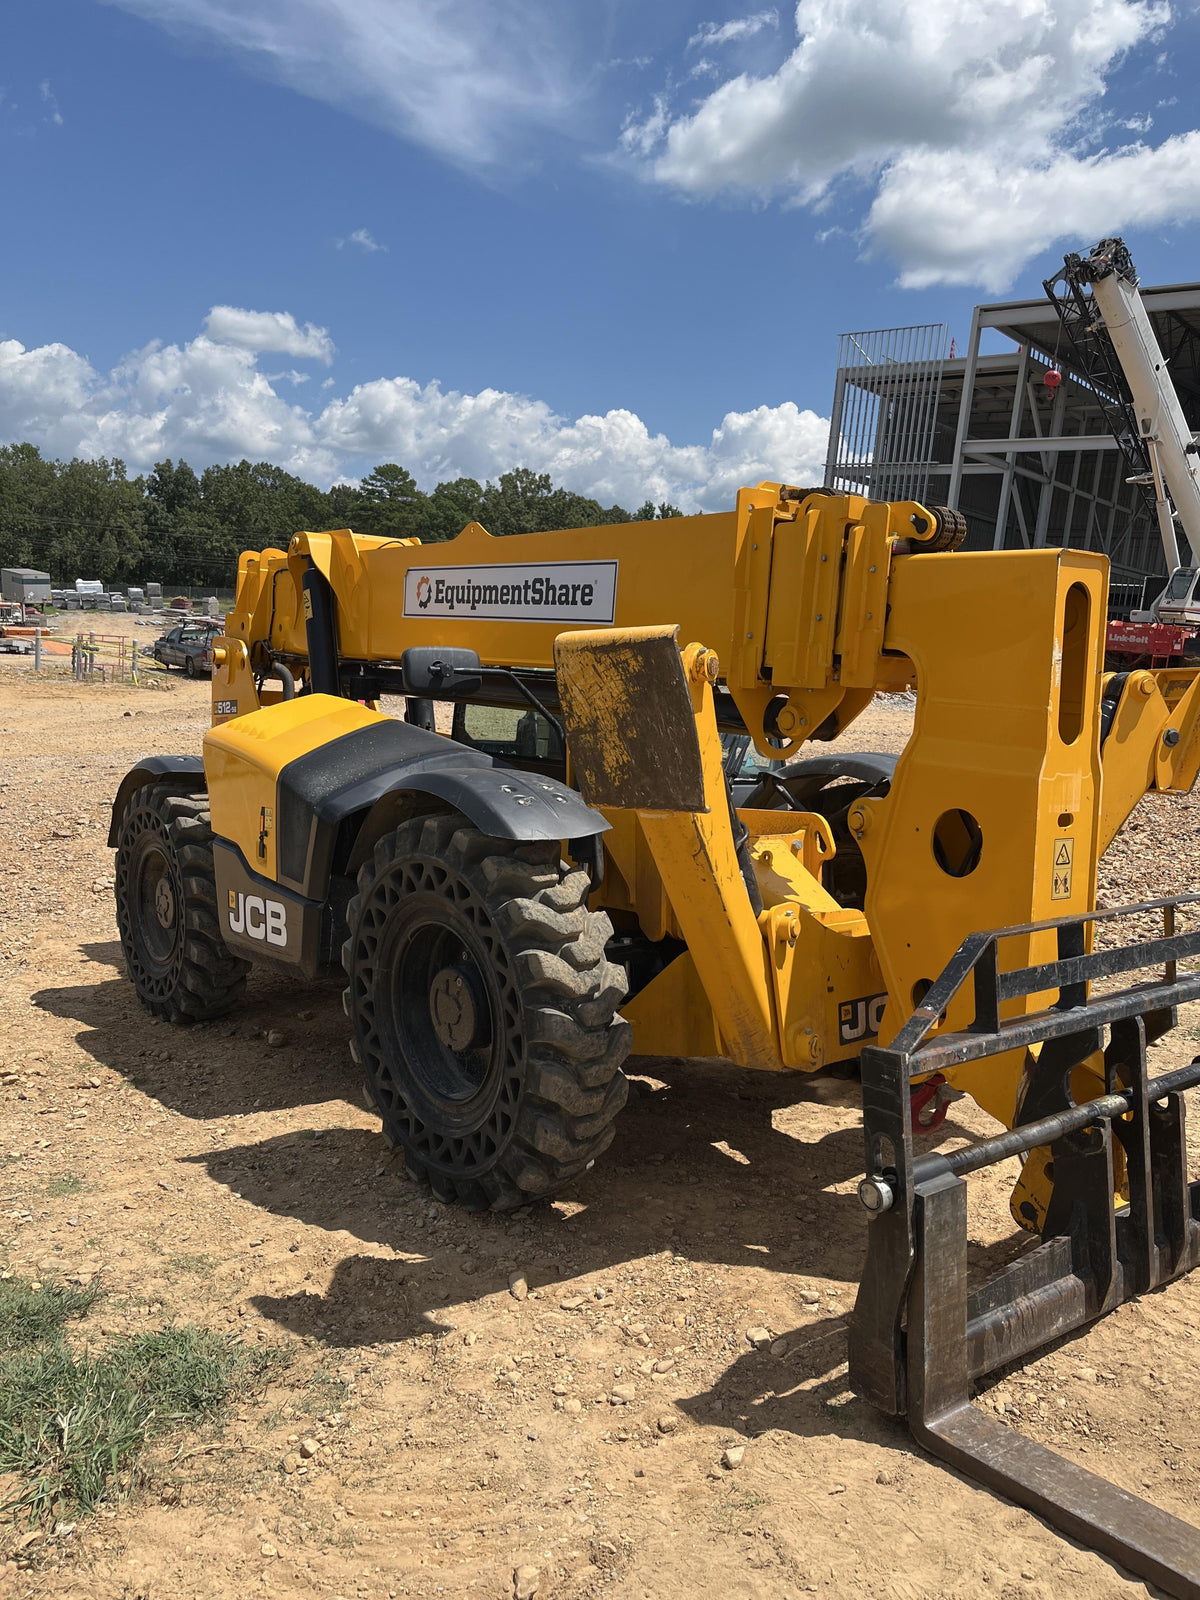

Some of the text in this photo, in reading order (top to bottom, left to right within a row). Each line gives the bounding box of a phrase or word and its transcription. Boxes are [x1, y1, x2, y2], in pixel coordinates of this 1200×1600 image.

[434, 577, 594, 610] EquipmentShare
[228, 892, 288, 947] JCB
[841, 995, 889, 1040] JC
